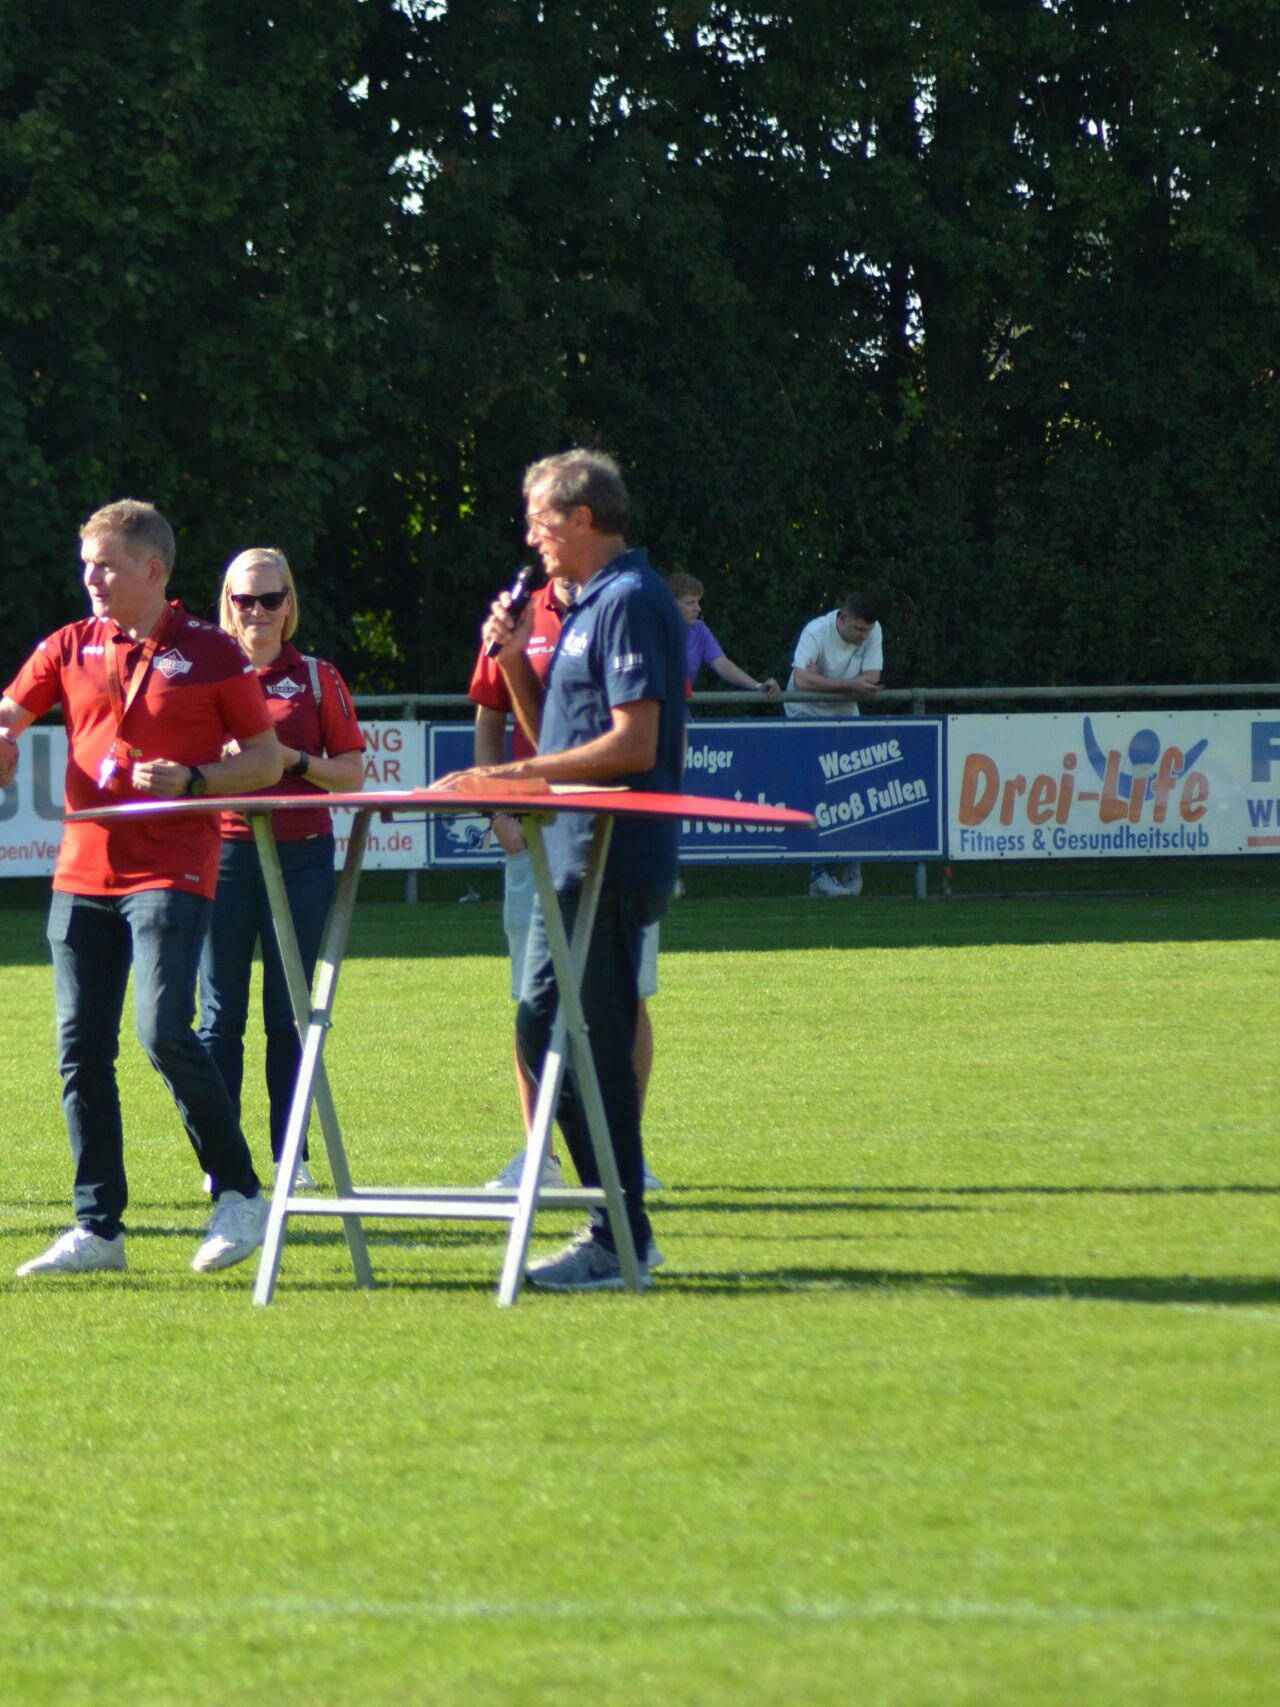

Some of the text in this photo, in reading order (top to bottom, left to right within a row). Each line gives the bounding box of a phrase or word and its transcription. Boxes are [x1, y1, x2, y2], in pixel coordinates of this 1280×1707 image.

[684, 745, 734, 774] Holger
[818, 738, 902, 779] Wesuwe
[815, 792, 865, 828] Groß
[867, 777, 928, 814] Fullen
[958, 746, 1210, 827] Drei-Life
[960, 824, 1210, 852] Fitness & Gesundheitsclub
